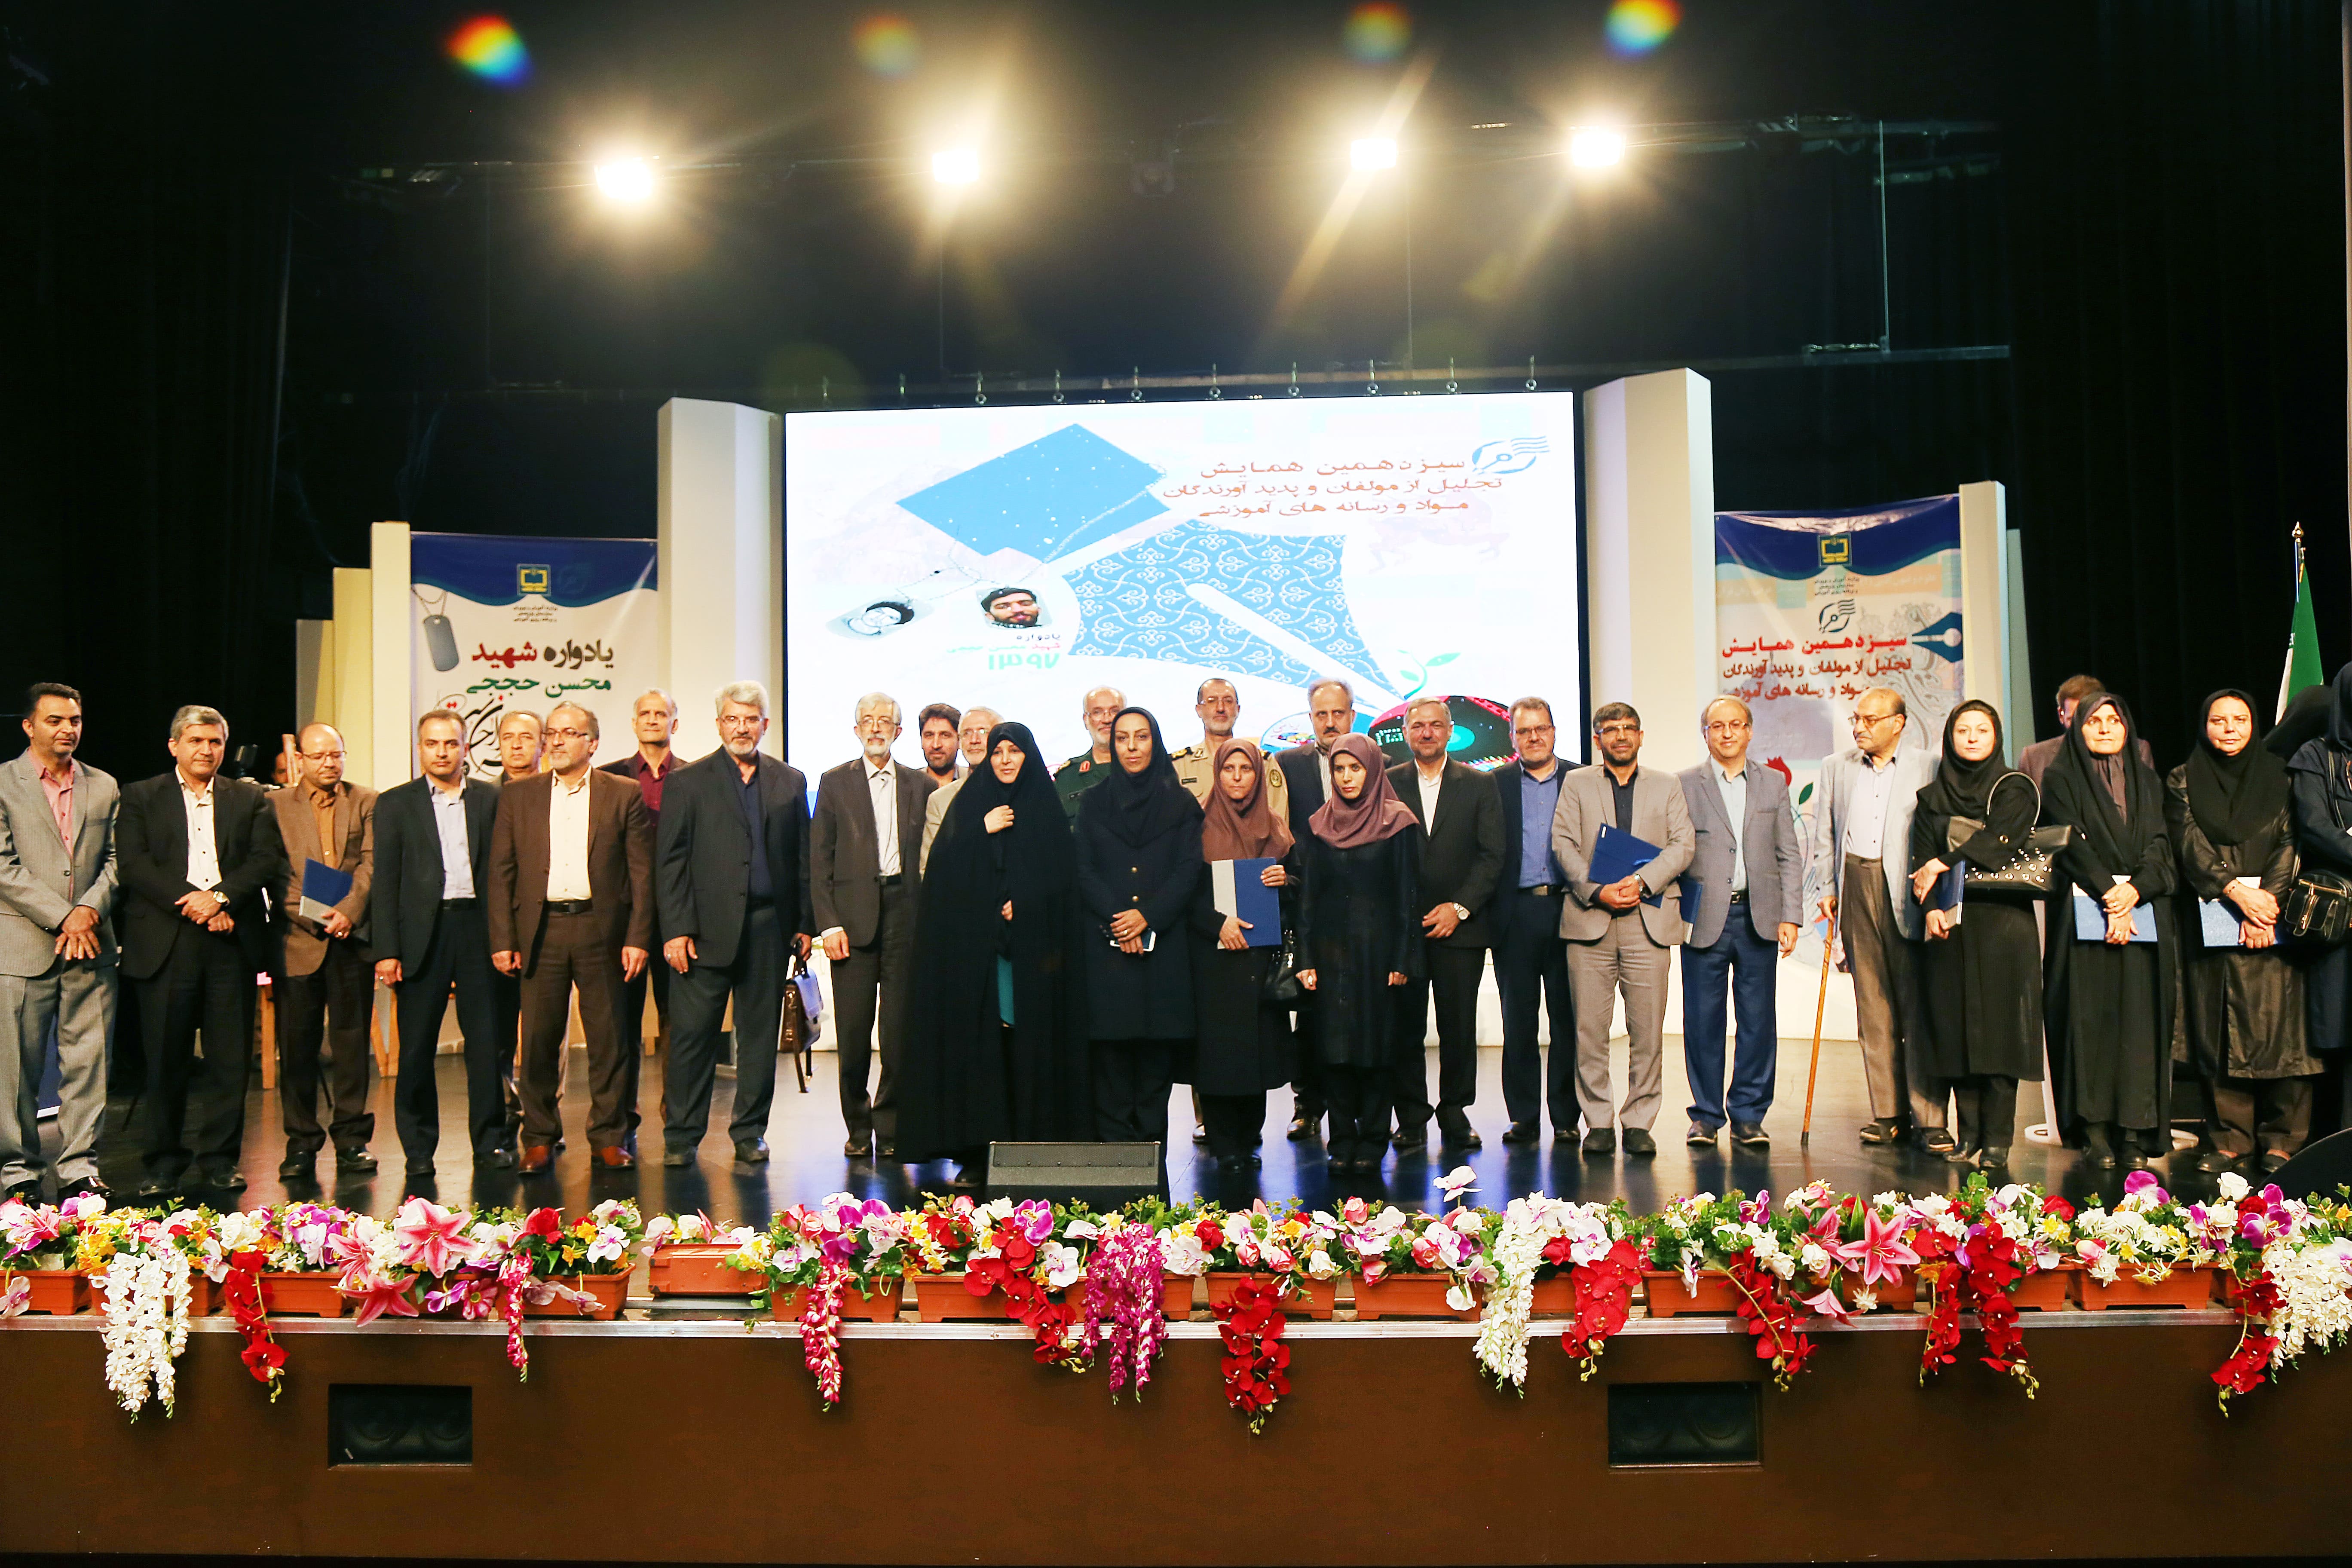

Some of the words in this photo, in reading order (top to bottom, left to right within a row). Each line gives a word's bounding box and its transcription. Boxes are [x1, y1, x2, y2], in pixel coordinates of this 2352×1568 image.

[1201, 462, 1303, 478] همایش
[1163, 481, 1248, 497] آورندگان
[1306, 485, 1317, 496] و
[1326, 481, 1399, 496] مولفان
[1403, 478, 1419, 493] از
[1427, 478, 1502, 494] تجلیل
[1199, 500, 1273, 518] آموزشی
[1279, 502, 1327, 516] های
[1336, 501, 1388, 513] رسانه
[1393, 503, 1406, 514] و
[1416, 499, 1469, 514] مواد
[1722, 636, 1795, 658] همایش
[1802, 634, 1907, 655] سیزدهمین
[472, 641, 537, 668] شهید
[543, 639, 614, 670] یادواره
[1797, 665, 1804, 677] و
[1809, 660, 1851, 678] مولفان
[1853, 658, 1864, 675] از
[1866, 656, 1912, 677] تجلیل
[466, 677, 540, 696] حججی
[545, 678, 611, 698] محسن
[1764, 683, 1791, 701] های
[1795, 683, 1825, 698] رسانه
[1828, 686, 1836, 699] و
